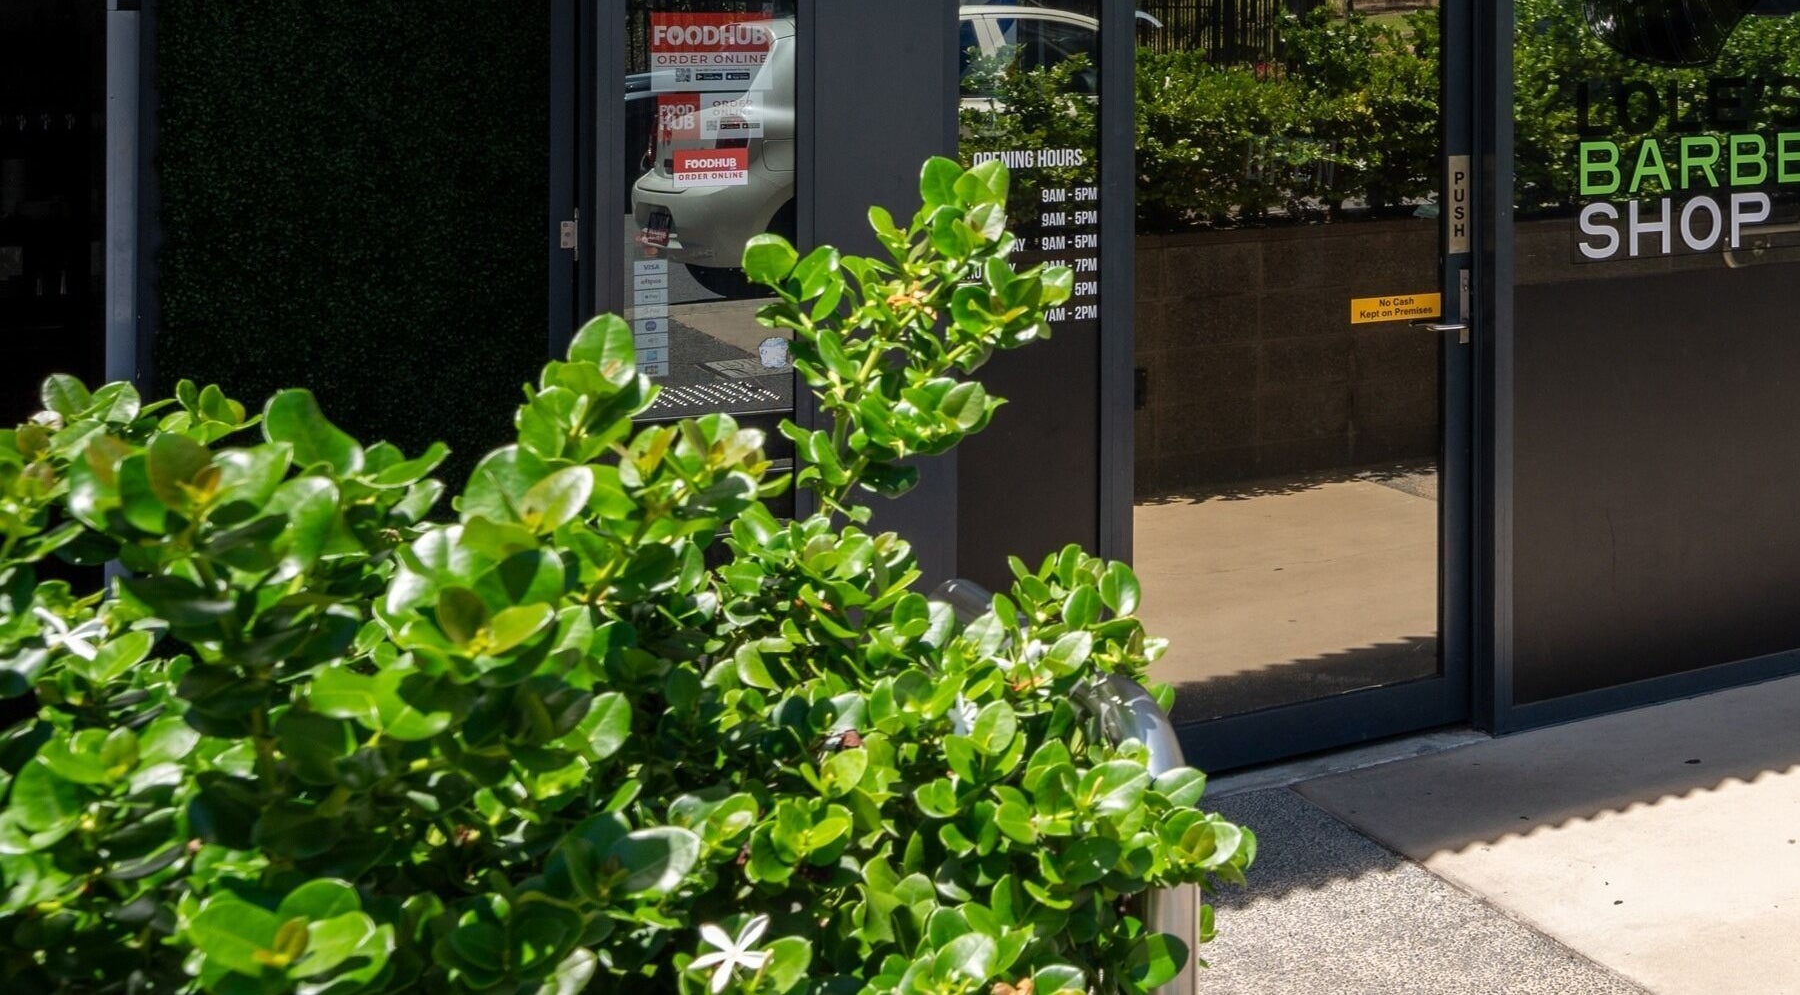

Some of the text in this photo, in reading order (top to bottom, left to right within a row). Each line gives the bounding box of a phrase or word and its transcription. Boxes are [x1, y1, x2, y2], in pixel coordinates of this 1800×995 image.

[654, 25, 767, 46] FOODHUB
[657, 54, 768, 64] ORDER ONLINE
[659, 103, 696, 116] FOOD
[659, 115, 696, 131] HUB
[685, 157, 737, 169] FOODHUB
[1037, 148, 1083, 168] HOURS
[678, 171, 744, 181] ORDER ONLINE
[1042, 188, 1066, 203] 9AM
[1074, 187, 1098, 201] 5PM
[1454, 171, 1465, 238] PUSH
[1041, 211, 1066, 226] 9AM
[1074, 210, 1098, 224] 5PM
[1578, 192, 1772, 260] SHOP
[1041, 236, 1066, 251] 9AM
[1074, 234, 1098, 248] 5PM
[1074, 258, 1098, 272] 7PM
[1074, 282, 1098, 296] 5PM
[1379, 297, 1415, 307] No Cash
[1074, 305, 1098, 319] 2PM
[1359, 309, 1380, 319] Kept
[1394, 306, 1433, 316] Premises
